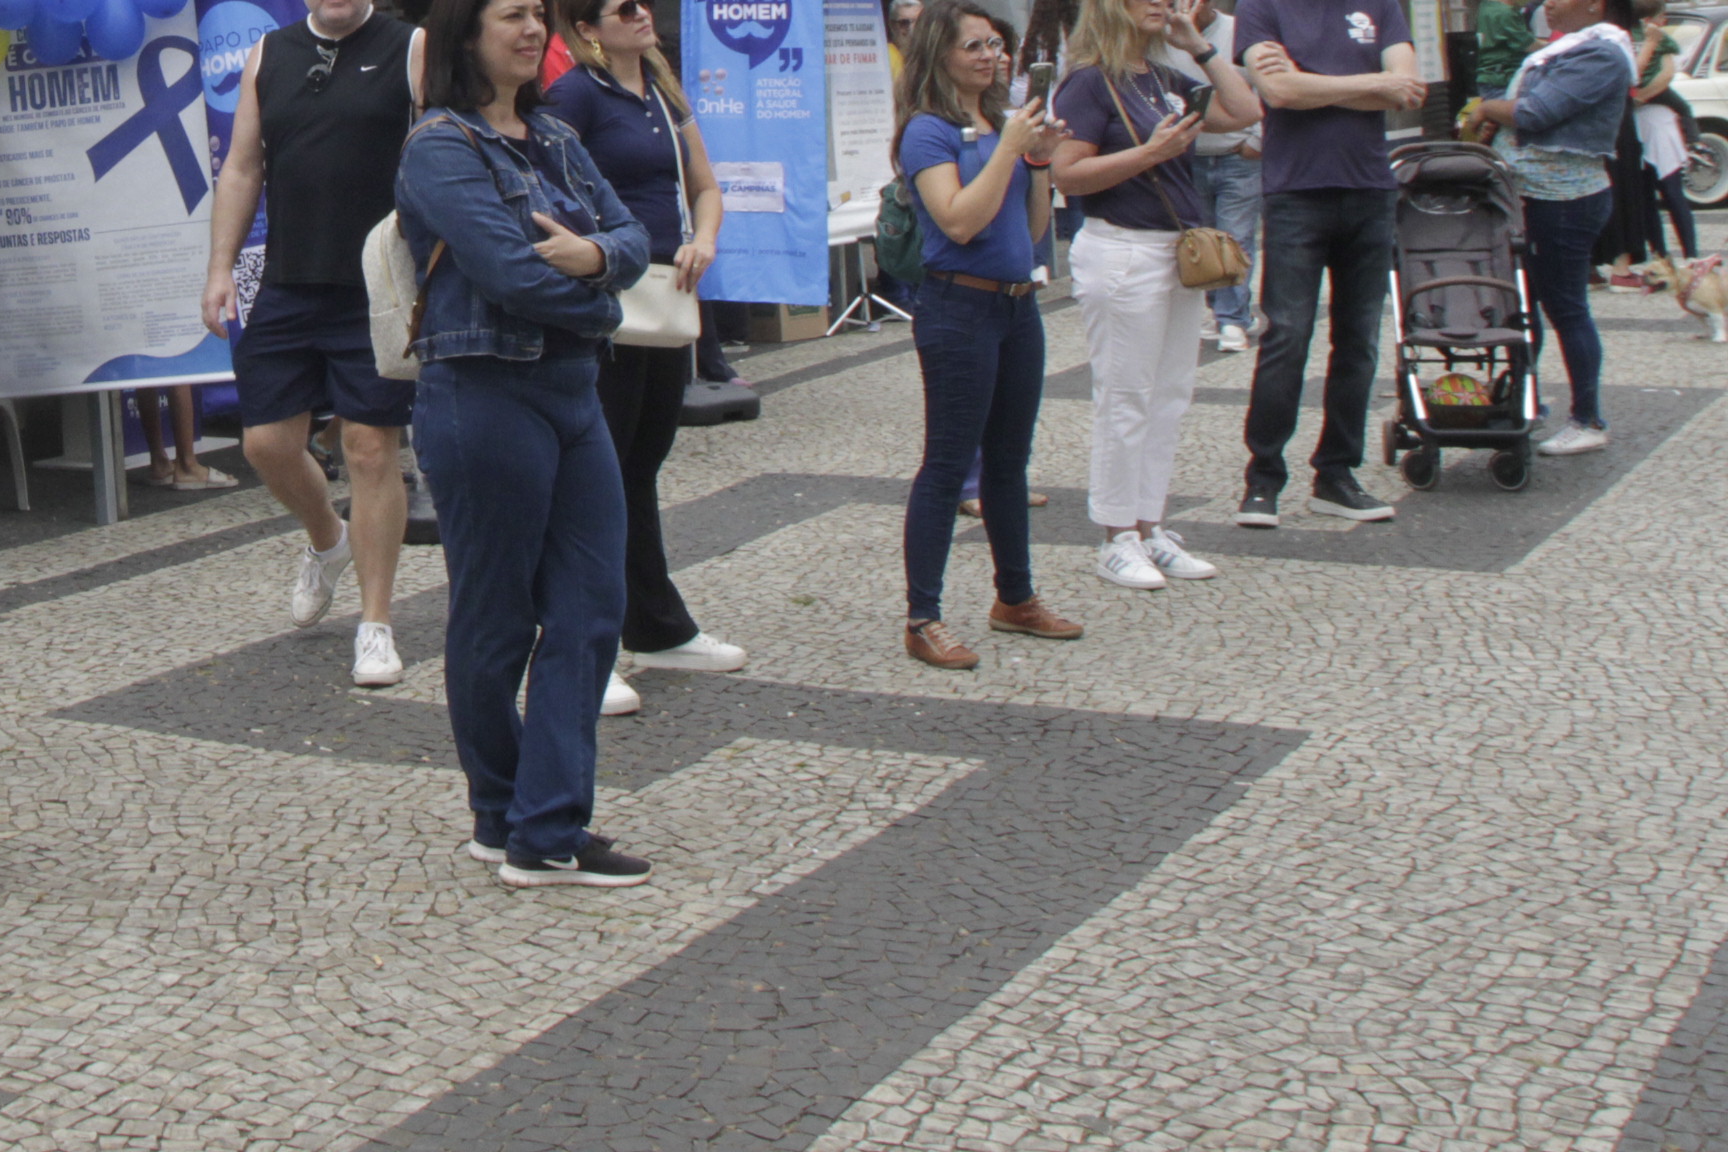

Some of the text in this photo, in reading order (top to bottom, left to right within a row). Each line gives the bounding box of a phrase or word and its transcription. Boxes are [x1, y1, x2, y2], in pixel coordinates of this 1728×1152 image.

[712, 3, 788, 21] HOMEM
[840, 53, 850, 64] DE
[853, 53, 877, 64] FUMAR
[8, 63, 121, 113] HOMEM
[5, 208, 32, 226] 90%
[31, 234, 36, 246] E
[37, 228, 91, 245] RESPOSTAS
